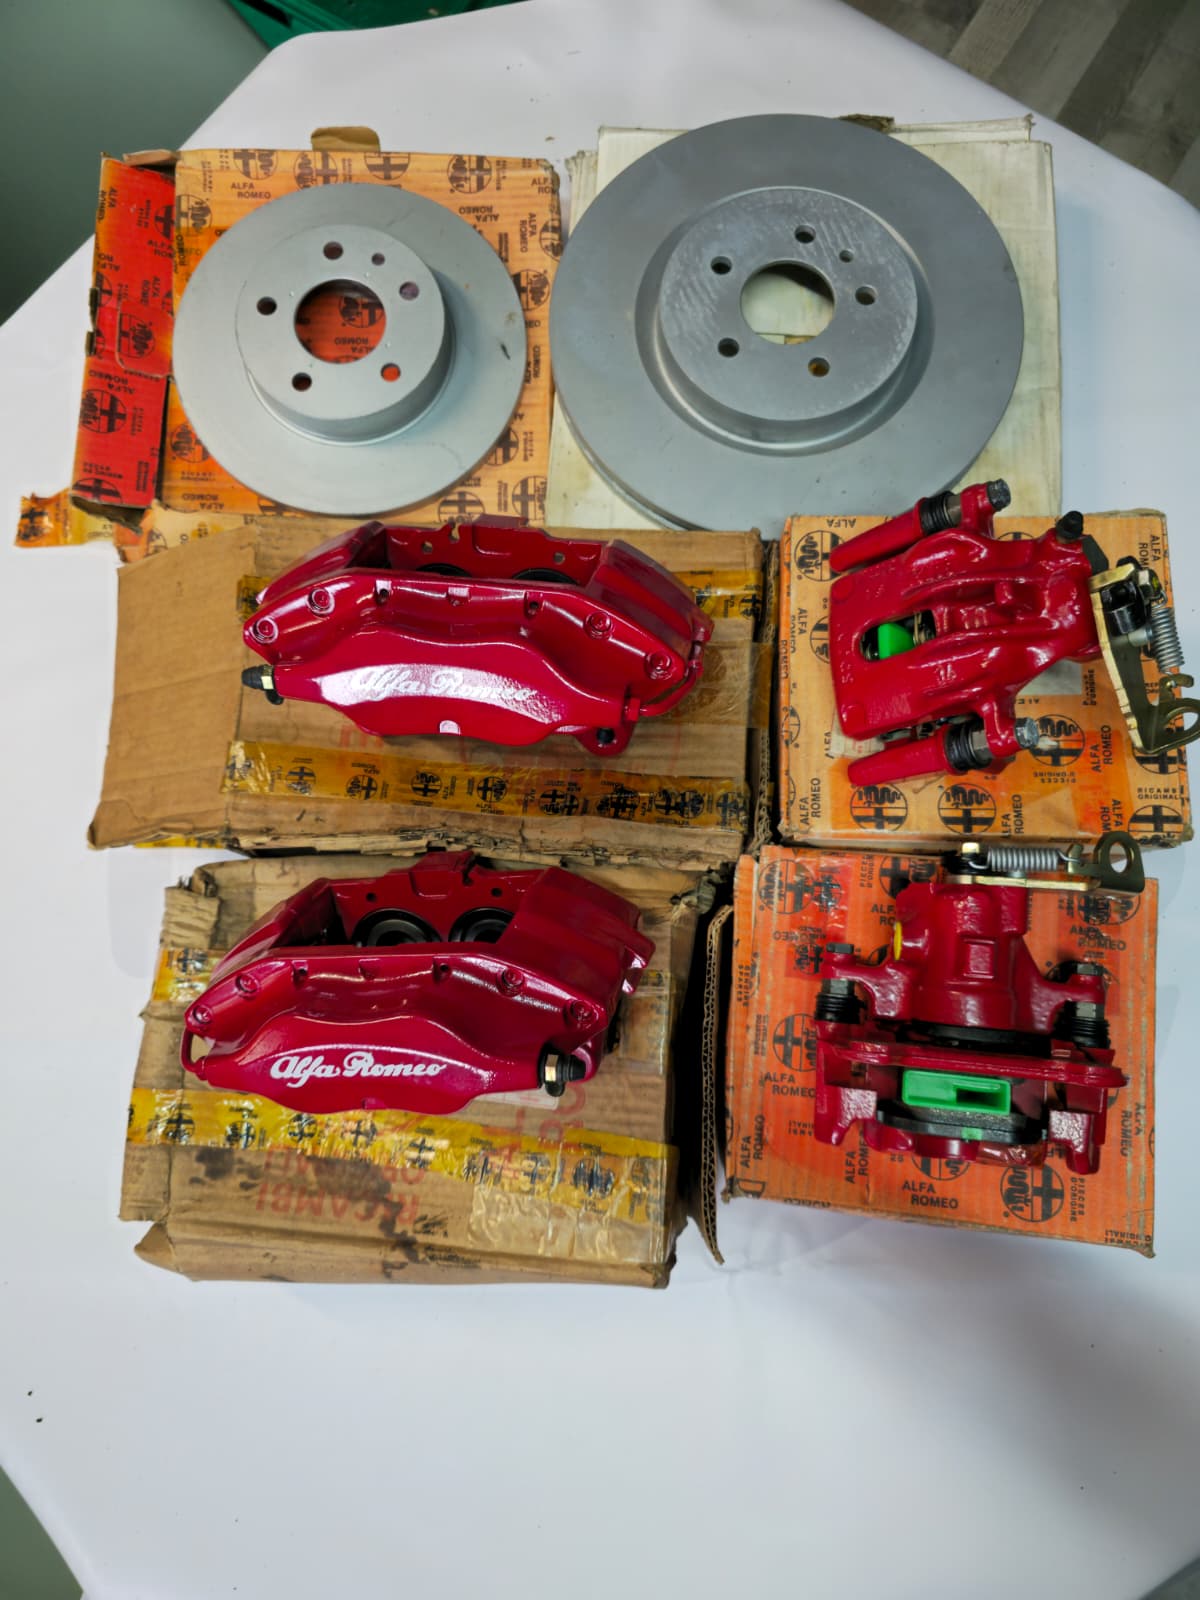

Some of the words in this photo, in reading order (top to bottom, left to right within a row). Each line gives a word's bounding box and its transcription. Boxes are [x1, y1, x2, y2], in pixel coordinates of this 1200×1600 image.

[231, 182, 255, 190] ALFA
[237, 191, 272, 199] ROMEO
[531, 177, 552, 186] ALF
[459, 205, 493, 214] ROMEO
[475, 214, 499, 222] ALFA
[520, 220, 528, 253] ROMEO
[529, 212, 537, 237] ALFA
[89, 369, 129, 385] ROMEO
[826, 518, 856, 528] ALFA
[1138, 542, 1149, 570] ROM
[1151, 534, 1161, 561] ALFA
[798, 607, 808, 635] ALFA
[352, 668, 427, 702] Alfa
[430, 669, 538, 701] Romeo
[1101, 724, 1113, 765] ROMEO
[1091, 744, 1101, 773] ALFA
[799, 796, 810, 825] ALFA
[811, 777, 821, 818] ROMEO
[1014, 794, 1023, 834] ROMEO
[1101, 806, 1111, 832] ROM
[1112, 798, 1124, 827] ALFA
[871, 904, 896, 914] ALF
[269, 1055, 341, 1089] Alfa
[343, 1051, 447, 1078] Romeo
[765, 1072, 796, 1084] ALFA
[772, 1084, 816, 1098] ROMEO
[753, 1114, 765, 1160] ROMEO
[1119, 1110, 1132, 1157] ROMEO
[740, 1135, 751, 1168] ALFA
[845, 1151, 856, 1184] ALFA
[902, 1180, 936, 1194] ALFA
[911, 1193, 959, 1209] ROMEO
